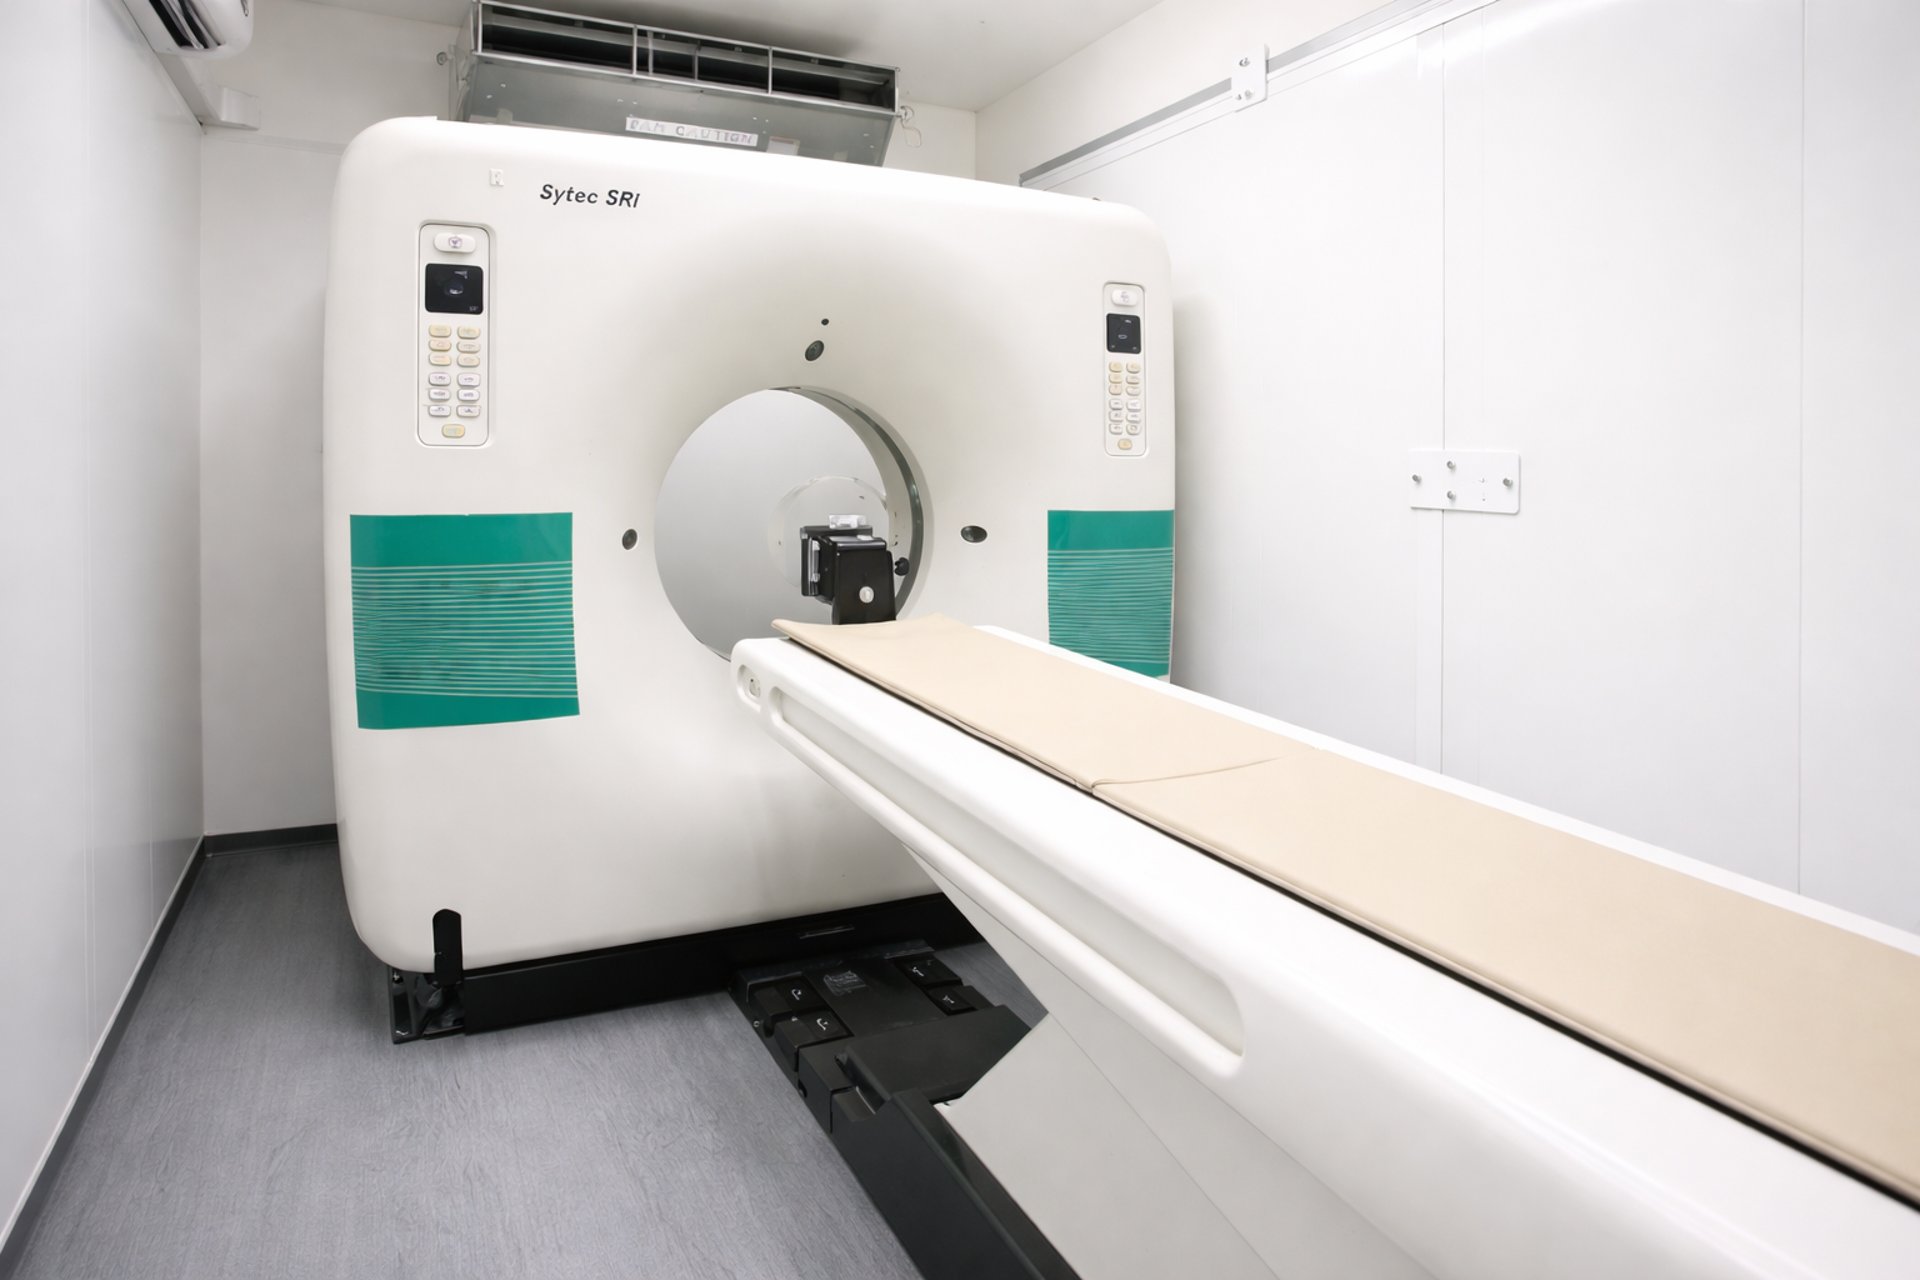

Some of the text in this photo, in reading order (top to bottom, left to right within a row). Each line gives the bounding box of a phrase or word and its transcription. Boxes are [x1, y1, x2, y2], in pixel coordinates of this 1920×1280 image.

[675, 126, 752, 144] CAUTION
[539, 183, 641, 208] Sytec SRI
